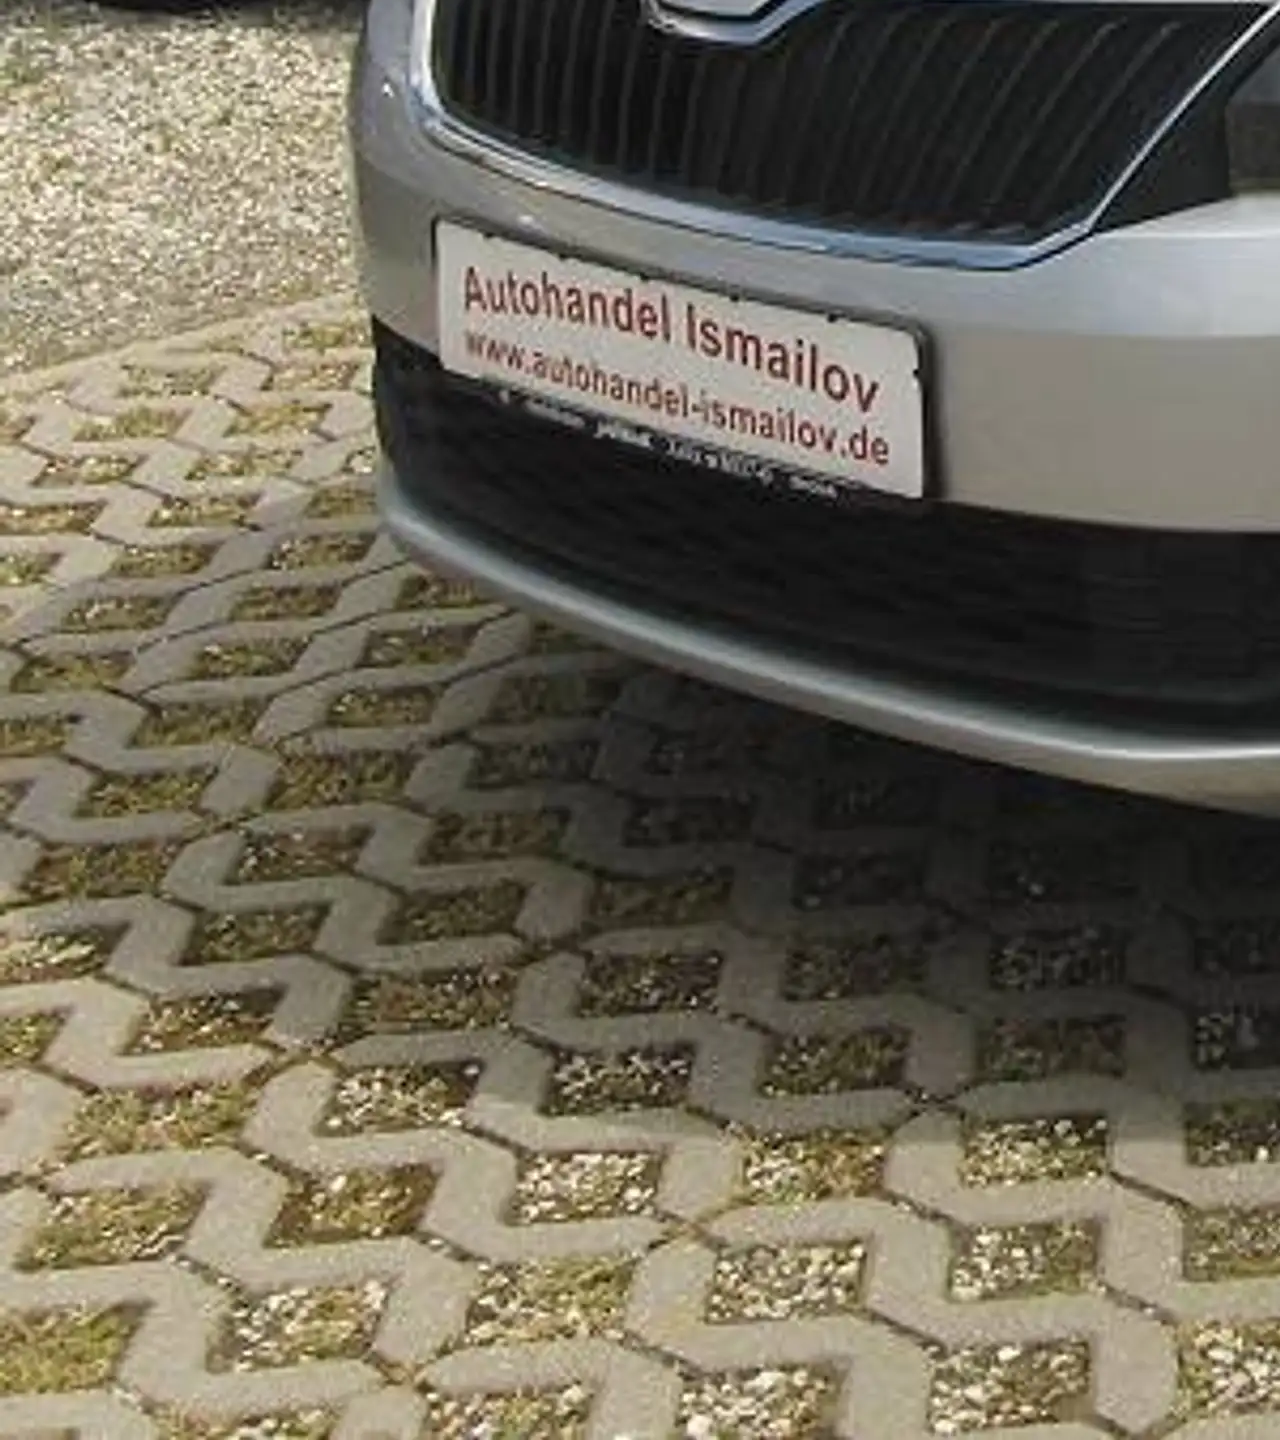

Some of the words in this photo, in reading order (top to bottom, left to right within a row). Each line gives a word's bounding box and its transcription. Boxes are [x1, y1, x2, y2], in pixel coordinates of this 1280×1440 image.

[464, 266, 672, 342] Autohandel
[687, 303, 881, 413] Ismailov
[464, 331, 891, 466] www.autohandel-ismailov.de
